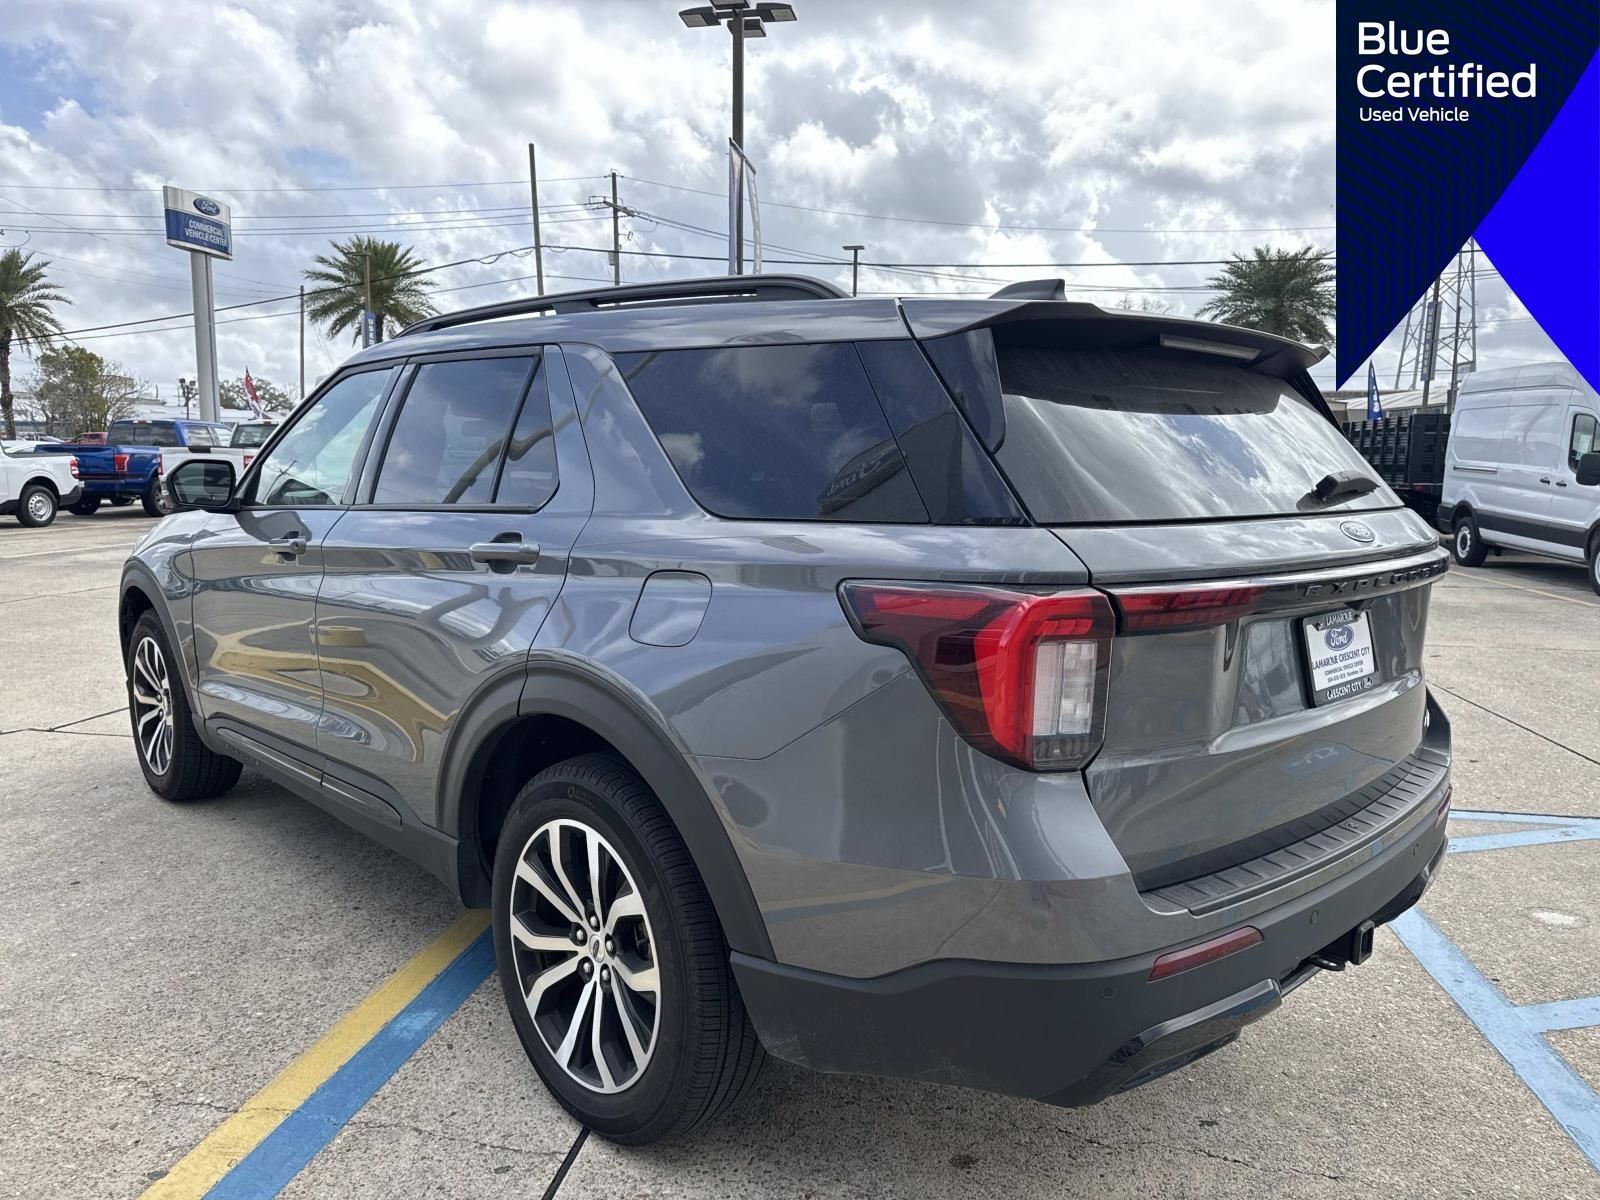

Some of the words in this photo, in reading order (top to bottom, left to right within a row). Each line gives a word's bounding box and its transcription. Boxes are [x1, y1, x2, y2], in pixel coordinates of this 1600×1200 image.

[201, 200, 217, 213] Ford
[185, 228, 209, 241] VEHICLE
[210, 235, 227, 245] CENTER
[189, 220, 224, 237] COMMERCIAL
[1303, 564, 1439, 597] EXPLORER
[1325, 612, 1353, 626] LAMARQUE
[1330, 628, 1348, 648] Ford
[1313, 655, 1338, 669] LAMARQUE
[1339, 648, 1360, 662] CRESCENT
[1361, 646, 1370, 656] CITY
[1327, 685, 1351, 701] CRESCENT
[1351, 680, 1362, 692] CITY
